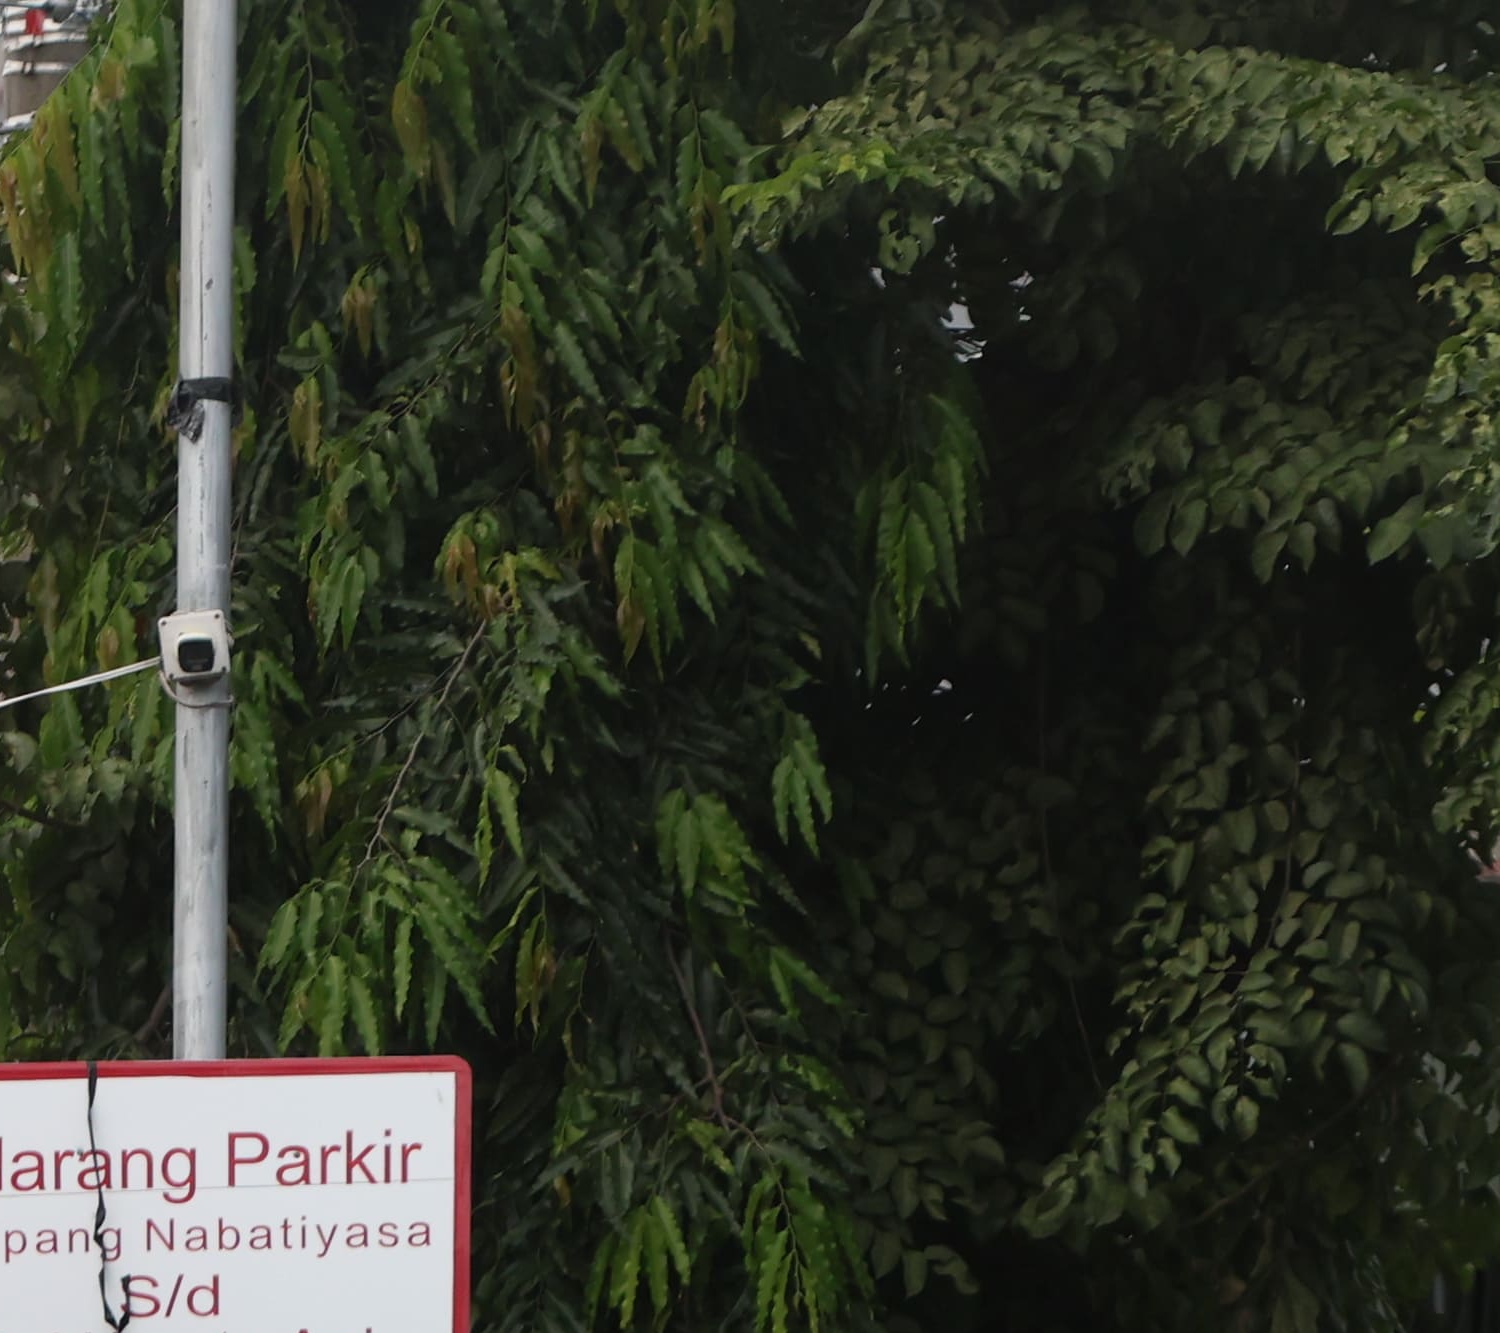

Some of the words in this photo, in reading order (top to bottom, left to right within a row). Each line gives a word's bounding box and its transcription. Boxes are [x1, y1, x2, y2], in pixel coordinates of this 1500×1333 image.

[228, 1129, 423, 1186] Parkir
[147, 1217, 433, 1257] Nabatiyasa
[122, 1273, 221, 1318] S/d
